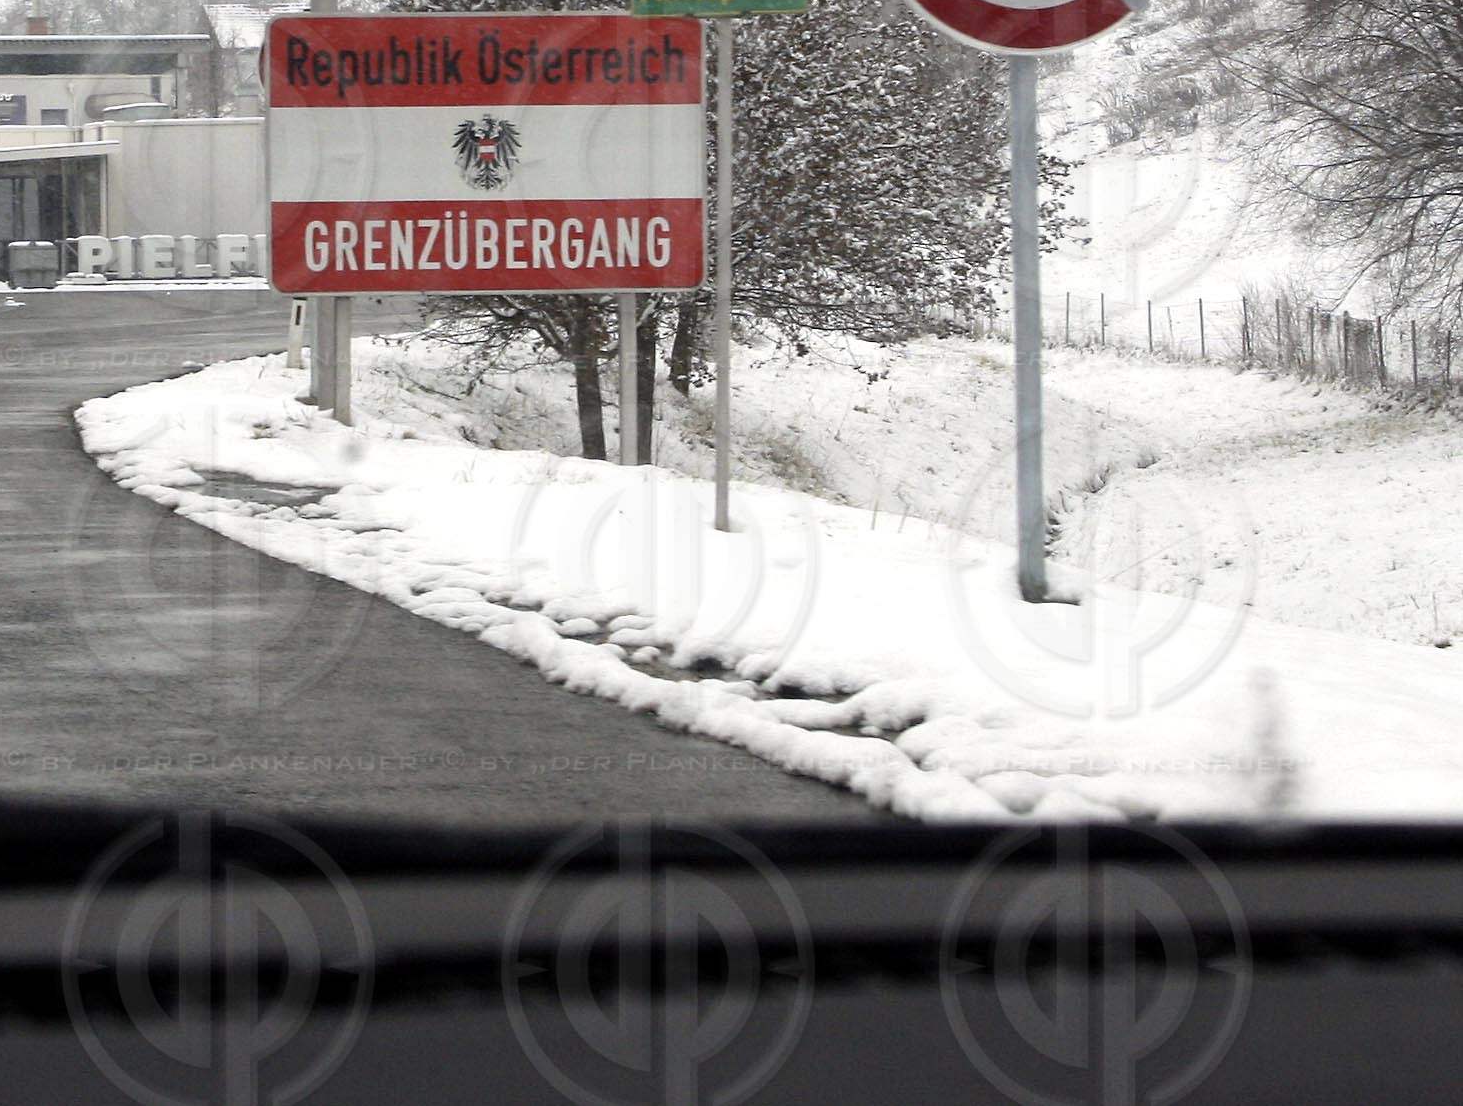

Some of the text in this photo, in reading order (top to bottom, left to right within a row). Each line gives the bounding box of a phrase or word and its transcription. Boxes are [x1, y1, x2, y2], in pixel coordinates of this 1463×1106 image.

[285, 28, 686, 97] Republik Österreich
[304, 210, 672, 272] GRENZÜBERGANG
